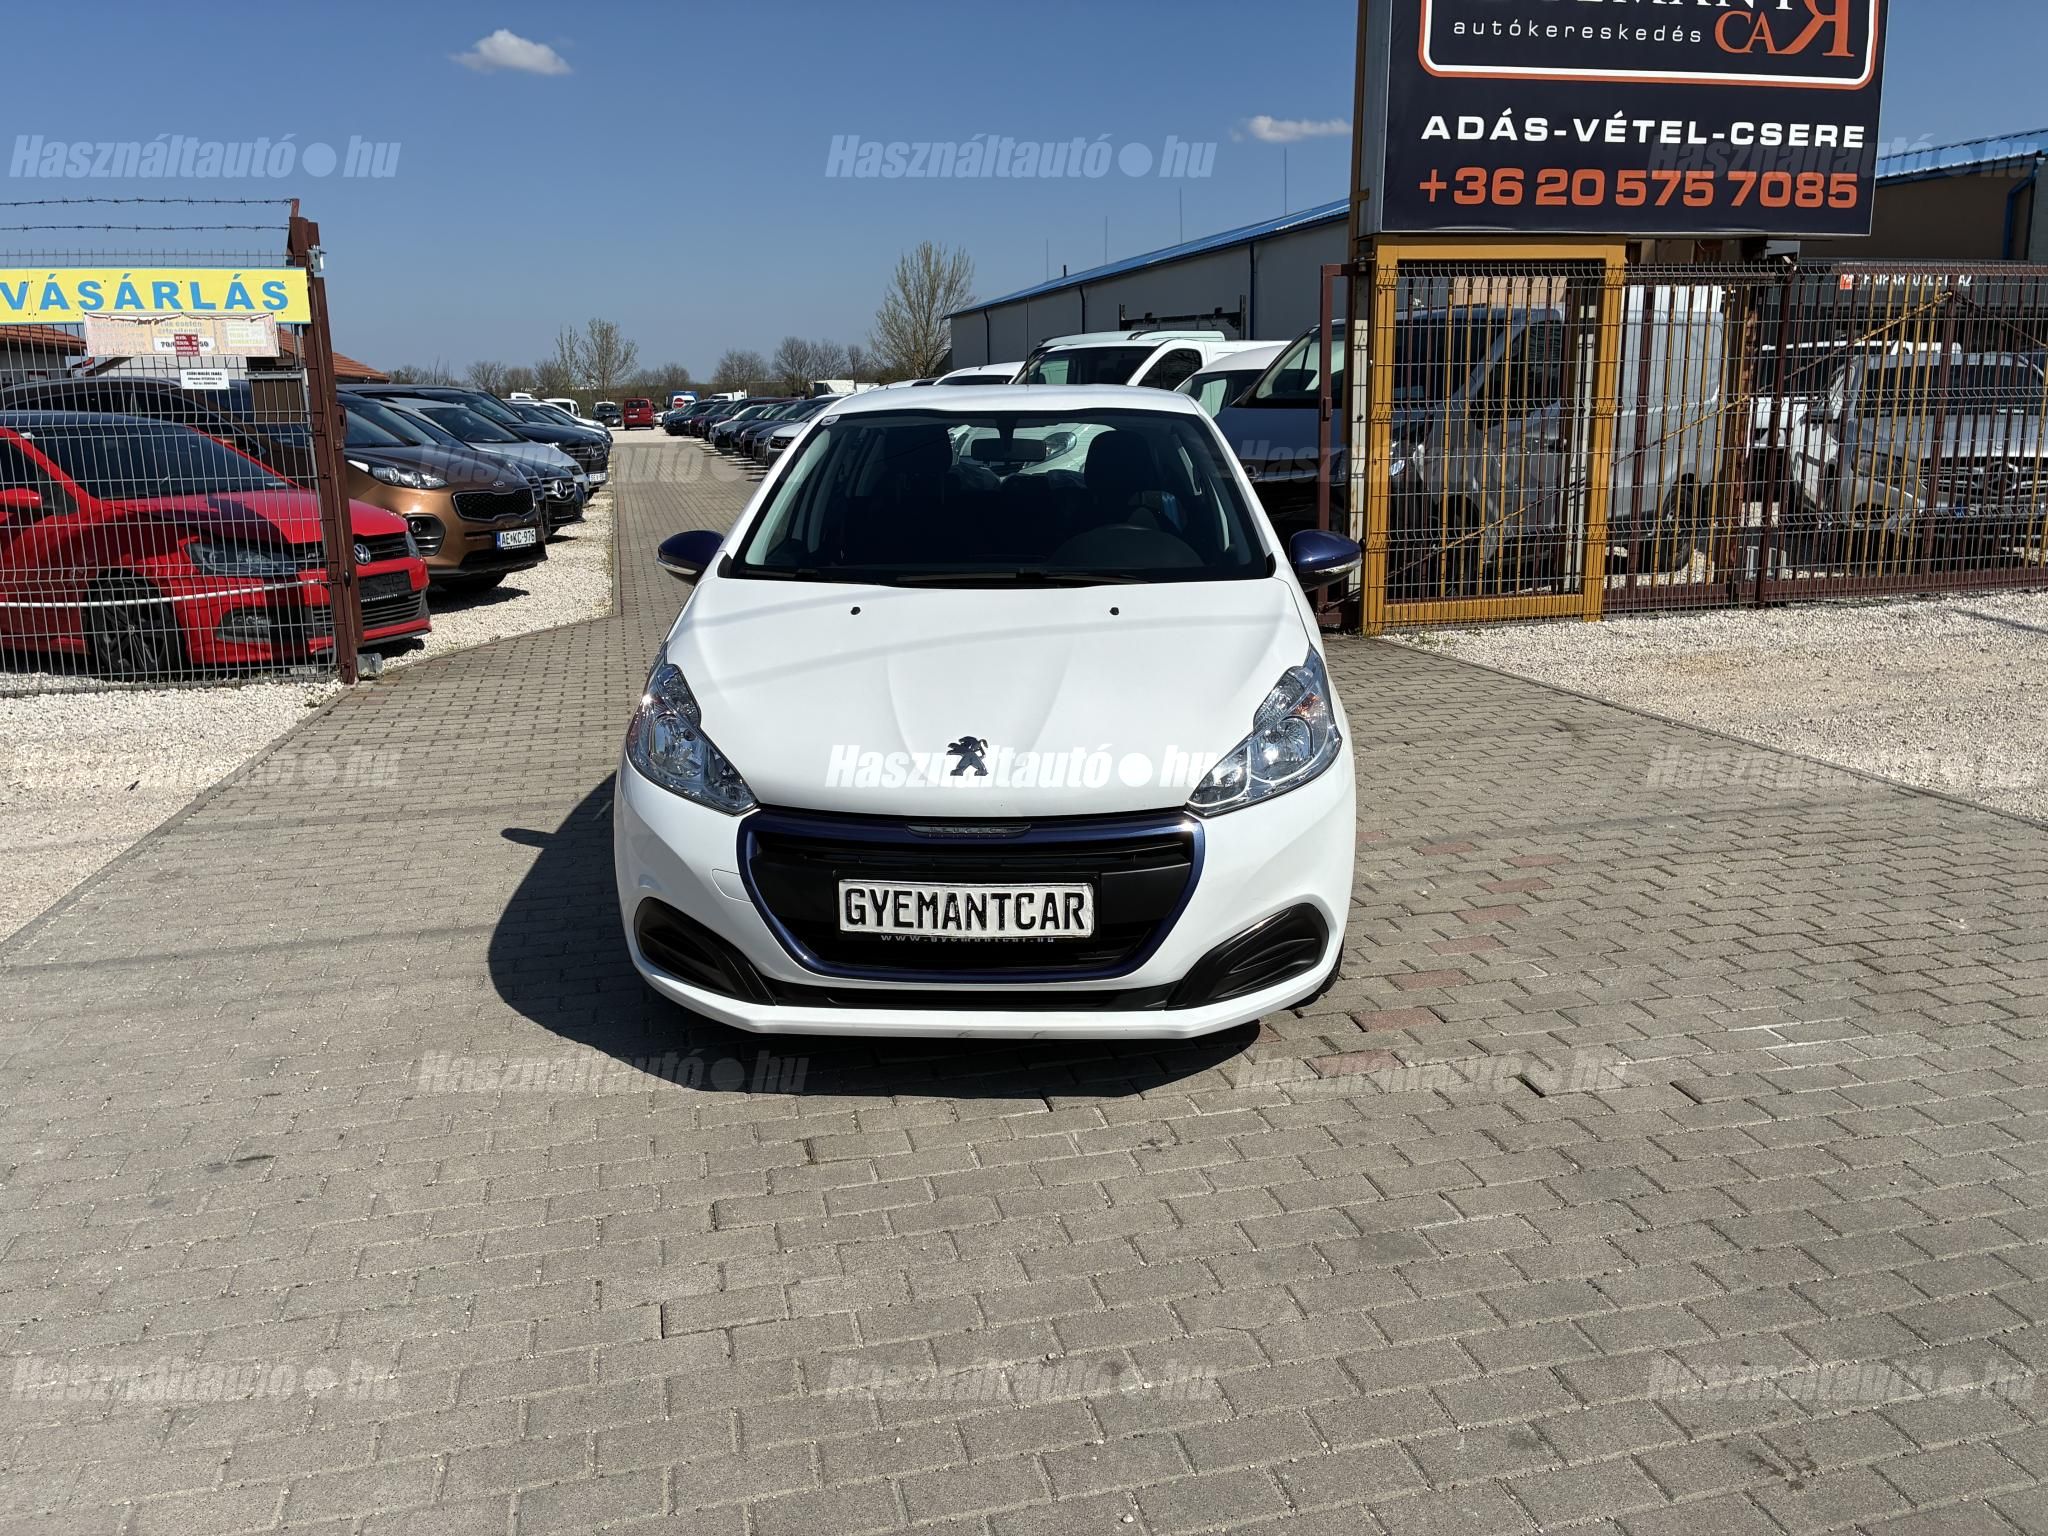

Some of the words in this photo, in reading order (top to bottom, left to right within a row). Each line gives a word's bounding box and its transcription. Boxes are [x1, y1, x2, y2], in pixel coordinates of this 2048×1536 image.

[1453, 17, 1702, 44] autókereskedés
[1421, 108, 1865, 149] ADÁS-VÉTEL-CSERE
[1419, 167, 1523, 206] +36
[1535, 168, 1606, 207] 20
[1615, 169, 1715, 208] 575
[1727, 170, 1858, 209] 7085
[0, 273, 289, 310] VÁSÁRLÁS
[845, 888, 1085, 931] GYEMANTCAR
